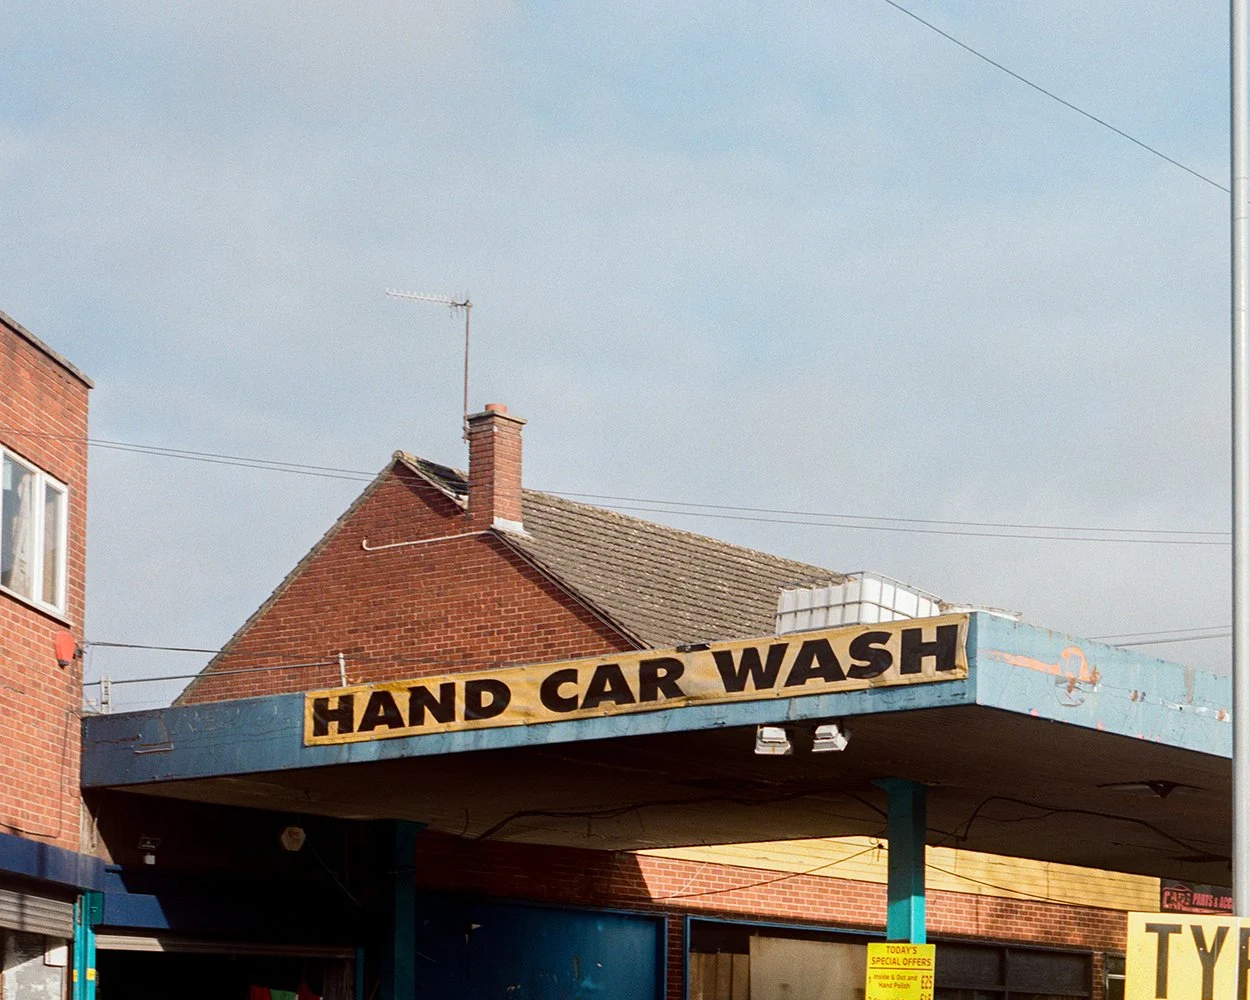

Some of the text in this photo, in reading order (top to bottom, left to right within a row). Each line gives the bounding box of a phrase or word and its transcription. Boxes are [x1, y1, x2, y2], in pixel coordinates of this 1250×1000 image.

[313, 624, 958, 737] HAND CAR WASH
[886, 945, 918, 955] TODAY'S
[871, 956, 932, 966] SPECIAL OFFERS
